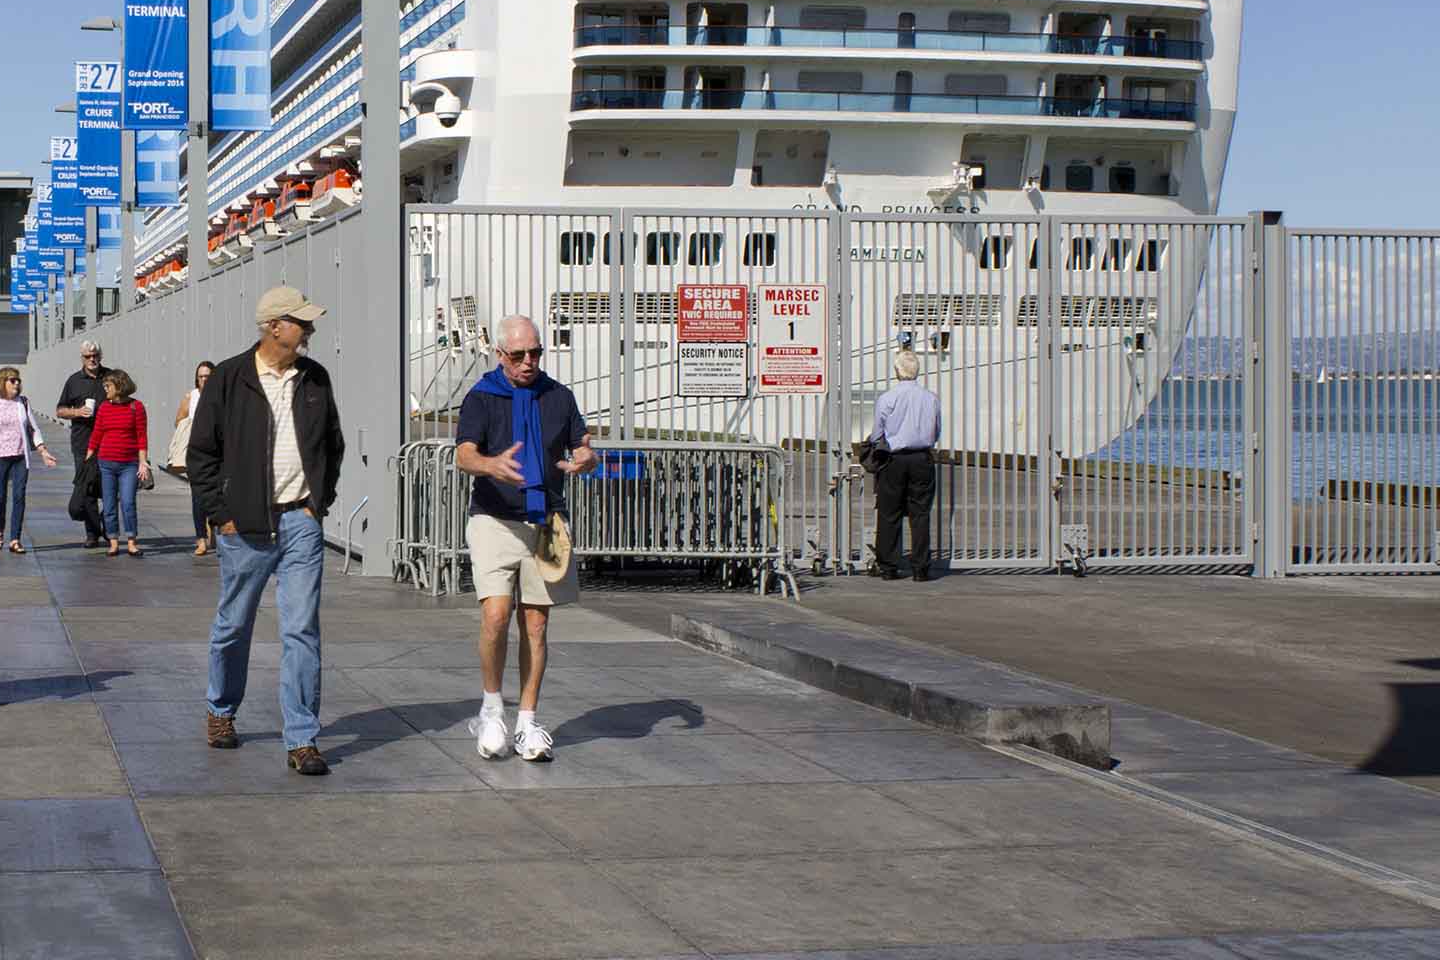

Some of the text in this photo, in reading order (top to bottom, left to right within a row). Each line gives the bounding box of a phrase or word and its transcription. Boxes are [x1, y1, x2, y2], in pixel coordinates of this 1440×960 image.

[127, 5, 186, 17] TERMINAL
[91, 64, 118, 89] 27
[128, 70, 151, 78] Grand
[84, 108, 113, 117] CRUISE
[133, 102, 169, 114] PORT
[79, 120, 119, 129] TERMINAL
[836, 248, 925, 260] AMILTON
[683, 288, 741, 300] SECURE
[765, 289, 819, 302] MARSEC
[692, 300, 733, 311] AREA
[773, 304, 811, 316] LEVEL
[703, 310, 744, 319] REQUIRED
[787, 321, 795, 341] 1
[681, 348, 744, 359] SECURITY NOTICE
